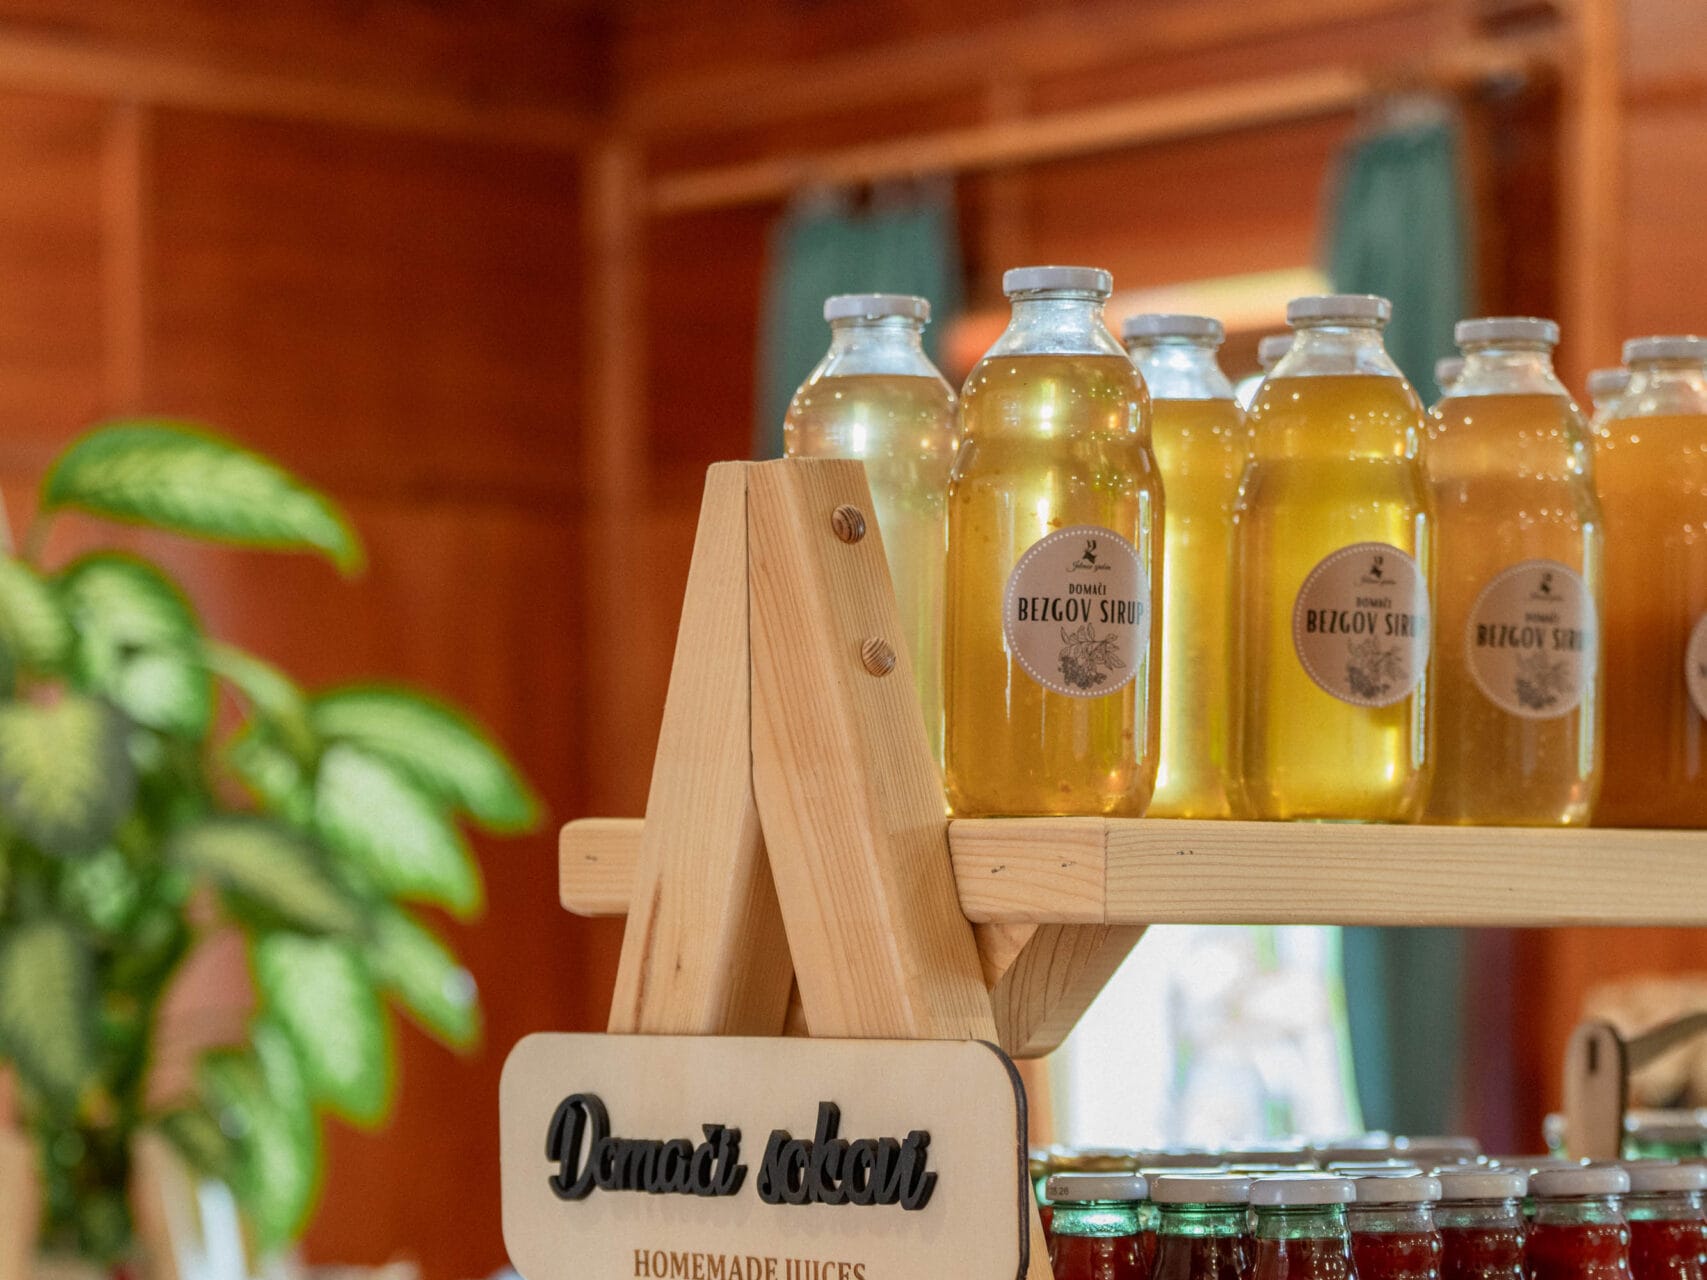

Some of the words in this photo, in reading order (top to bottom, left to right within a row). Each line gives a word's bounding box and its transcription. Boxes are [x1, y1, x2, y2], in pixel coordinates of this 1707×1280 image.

[1068, 582, 1107, 595] DOMAČI
[1018, 597, 1092, 622] BEZGOV
[1100, 599, 1144, 625] SIRUP
[1306, 609, 1378, 635] BEZGOV
[545, 1092, 748, 1200] Domači
[756, 1101, 938, 1211] sokovi
